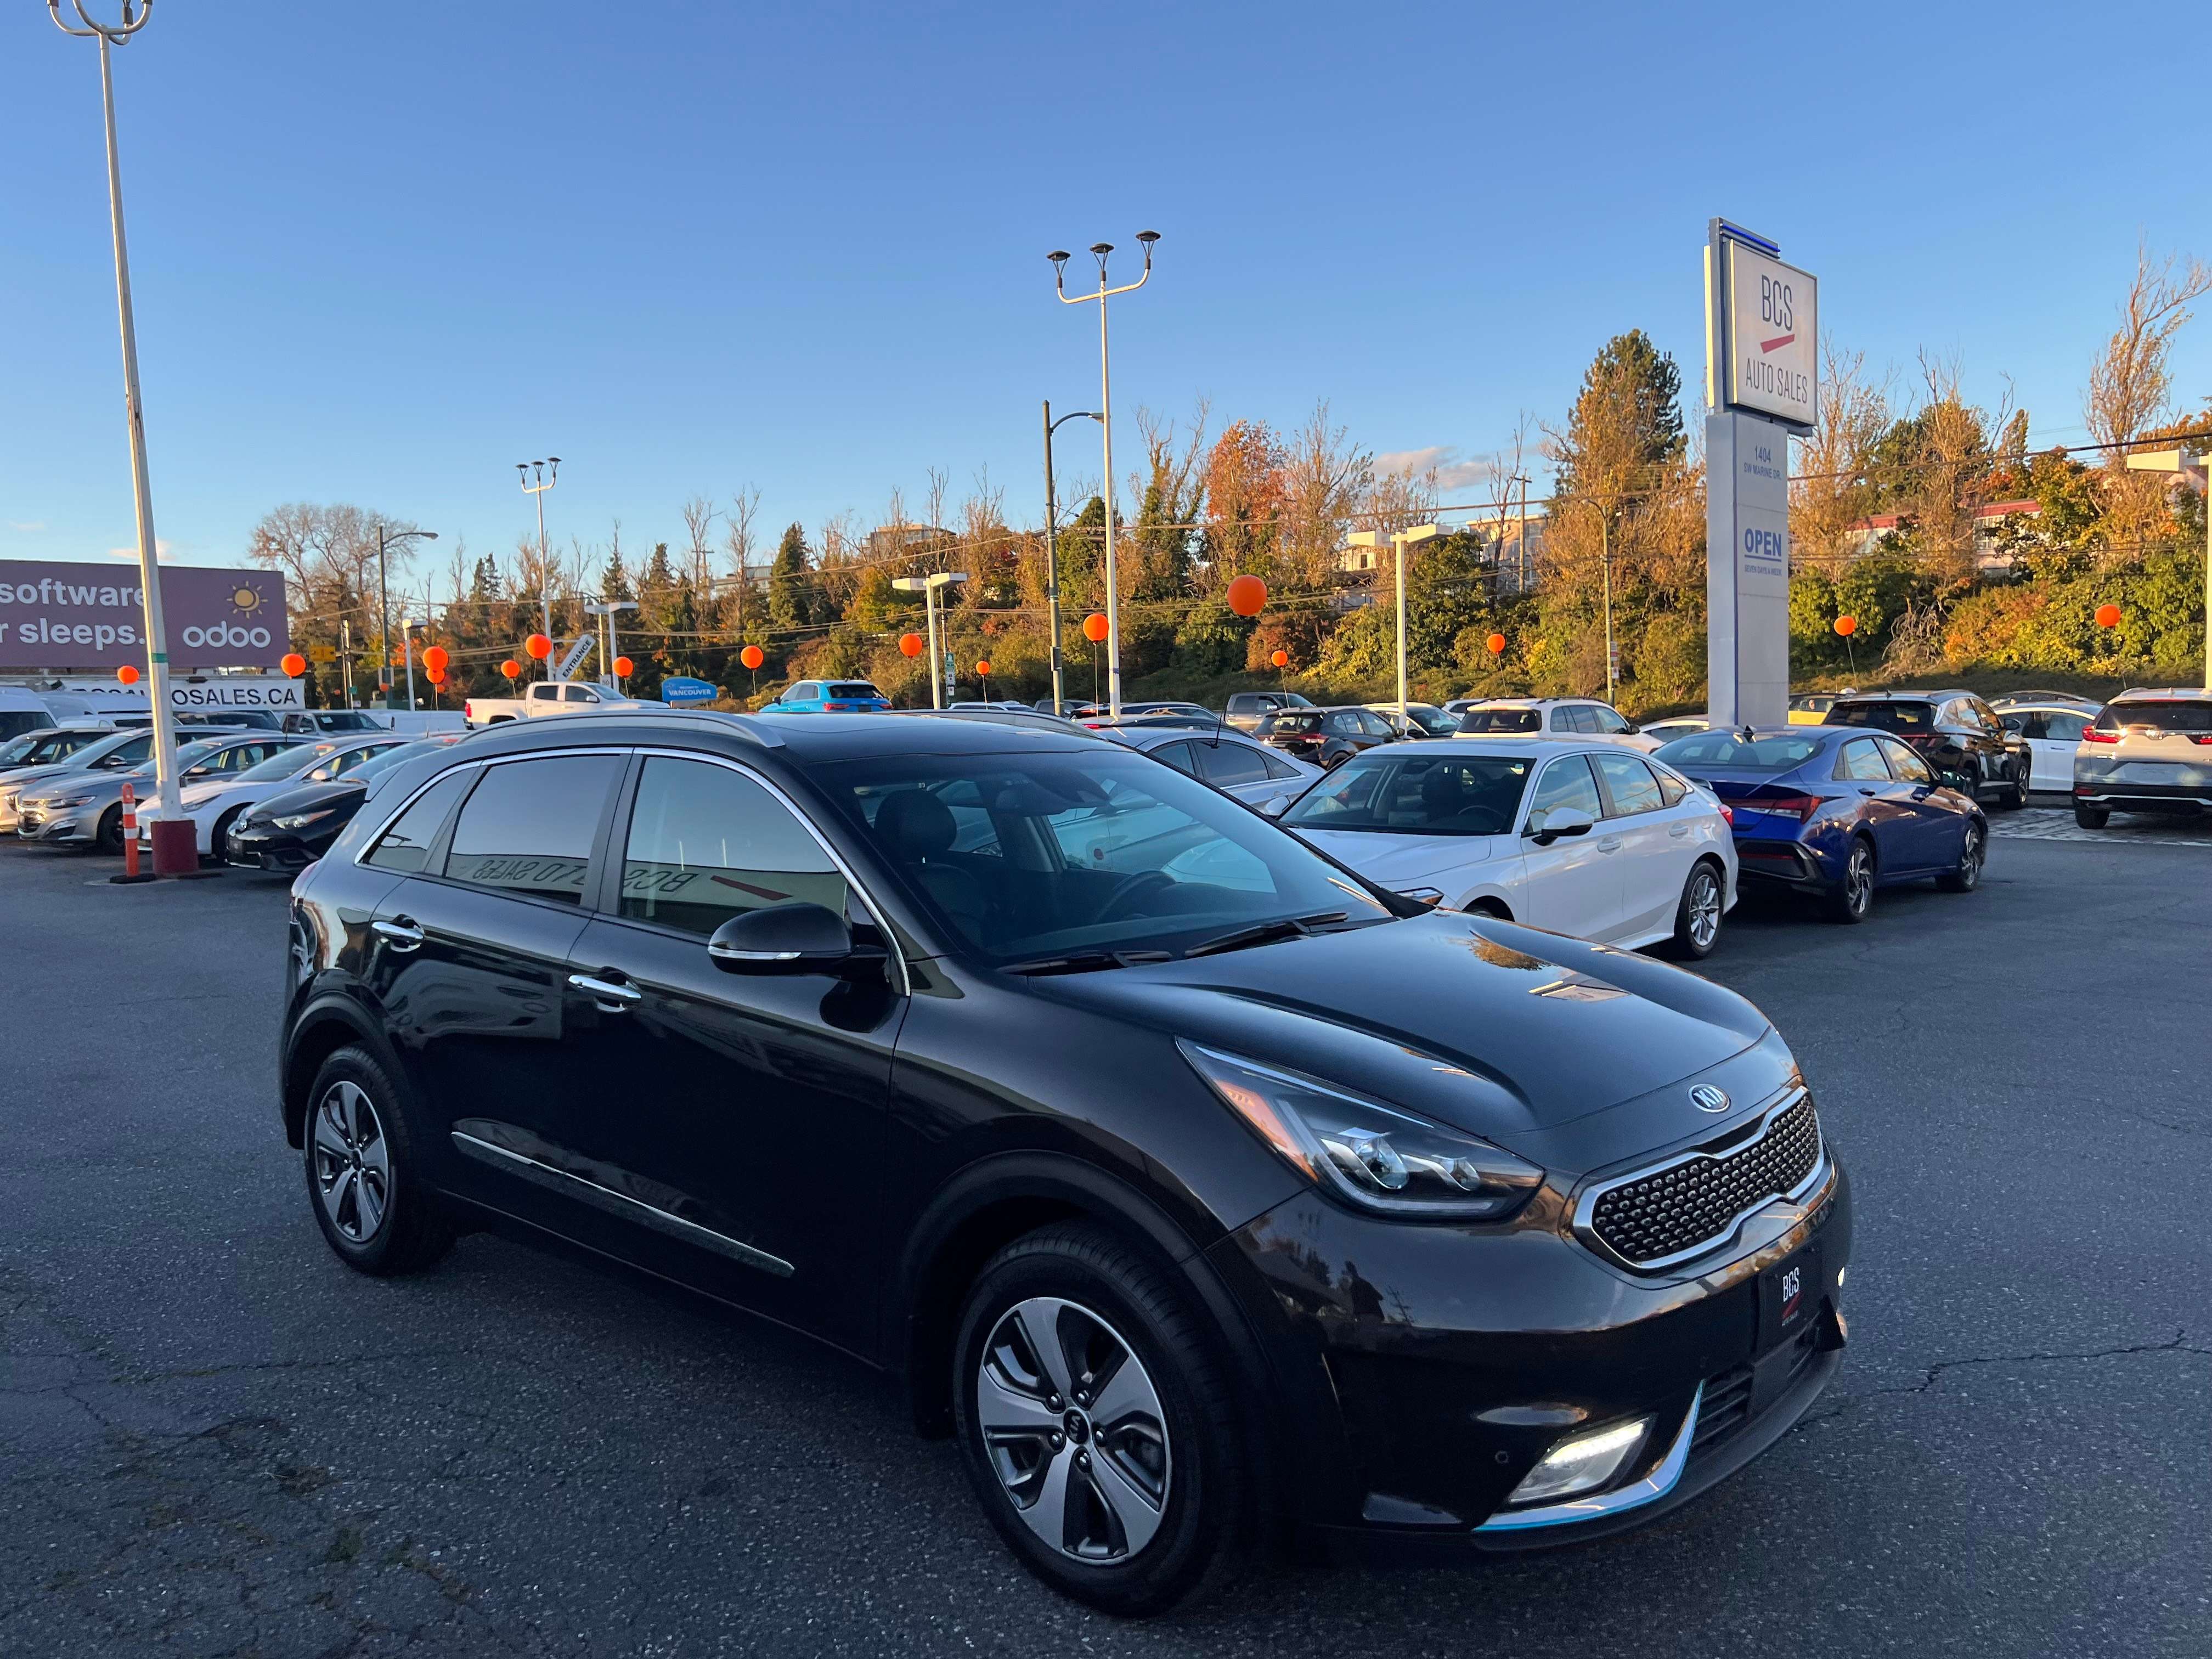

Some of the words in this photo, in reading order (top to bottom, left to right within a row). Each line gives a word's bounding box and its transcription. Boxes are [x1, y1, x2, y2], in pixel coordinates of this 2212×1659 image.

[1762, 274, 1793, 331] BCS
[1746, 358, 1774, 394] AUTO
[1778, 368, 1807, 404] SALES
[1755, 445, 1771, 464] 1404
[1745, 528, 1781, 557] OPEN
[19, 618, 145, 650] sleeps.
[183, 620, 271, 648] odoo
[562, 639, 591, 678] ENTRANCE
[1693, 1086, 1723, 1108] KIA
[1783, 1267, 1799, 1302] BCS
